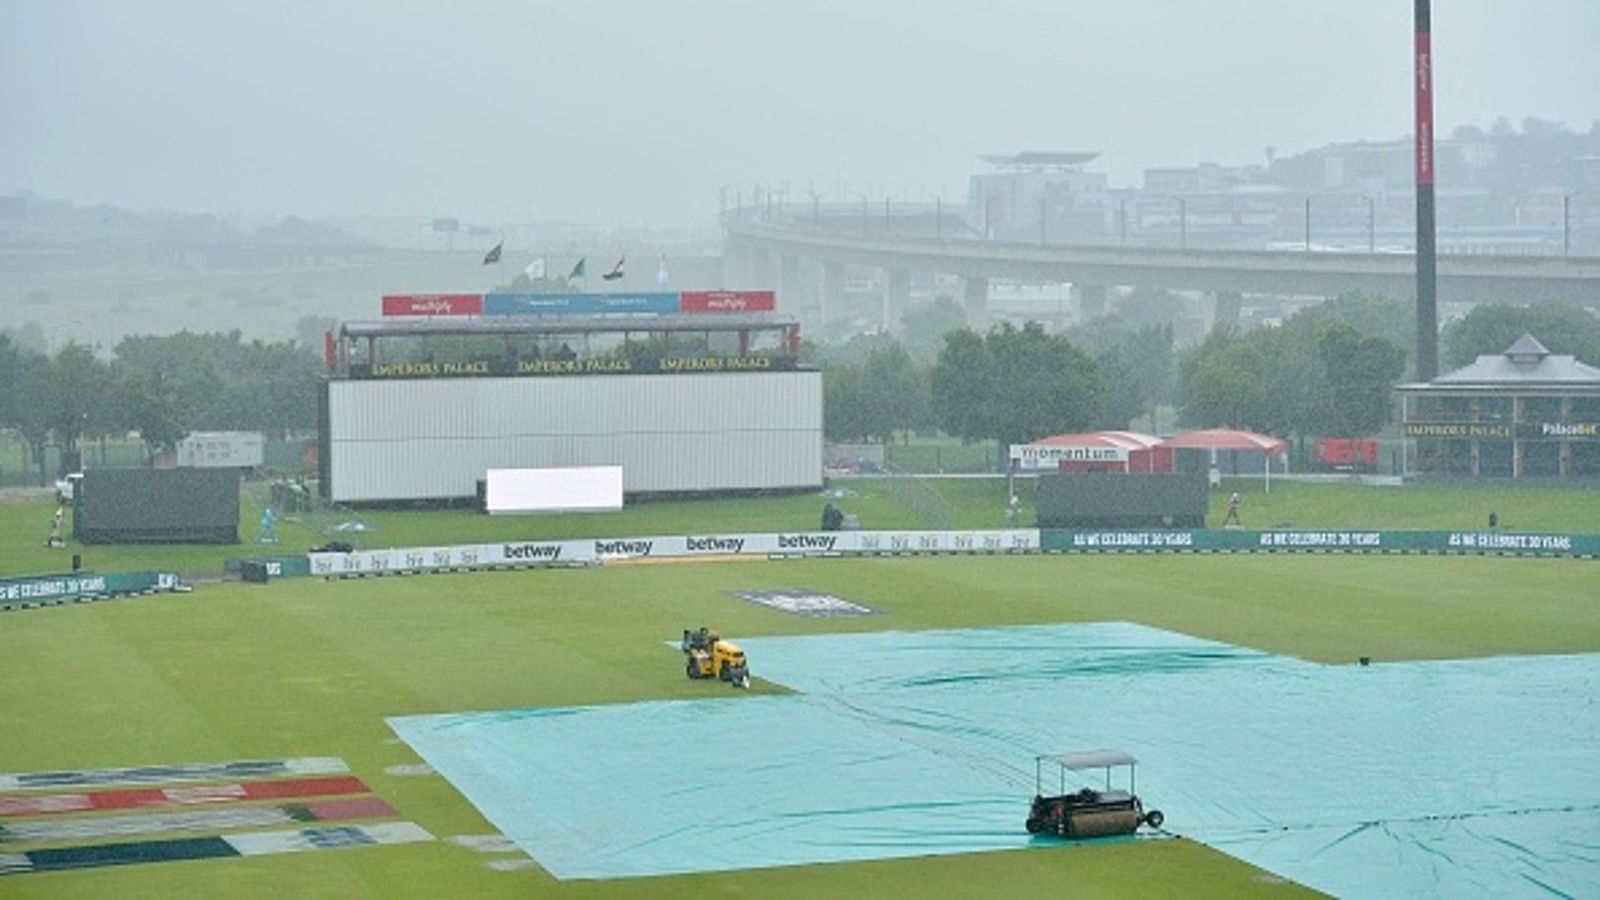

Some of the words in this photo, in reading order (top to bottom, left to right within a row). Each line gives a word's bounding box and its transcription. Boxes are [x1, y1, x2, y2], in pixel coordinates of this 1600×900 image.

[373, 361, 439, 375] EMPERORS
[444, 360, 488, 374] PALACE
[517, 360, 582, 373] EMPERORS
[587, 358, 632, 371] PALACE
[660, 358, 723, 371] EMPERORS
[727, 357, 769, 369] PALACE
[1022, 446, 1119, 460] momentum
[595, 541, 653, 556] betway
[687, 536, 745, 553] betway
[778, 533, 837, 549] betway
[504, 544, 562, 560] betway
